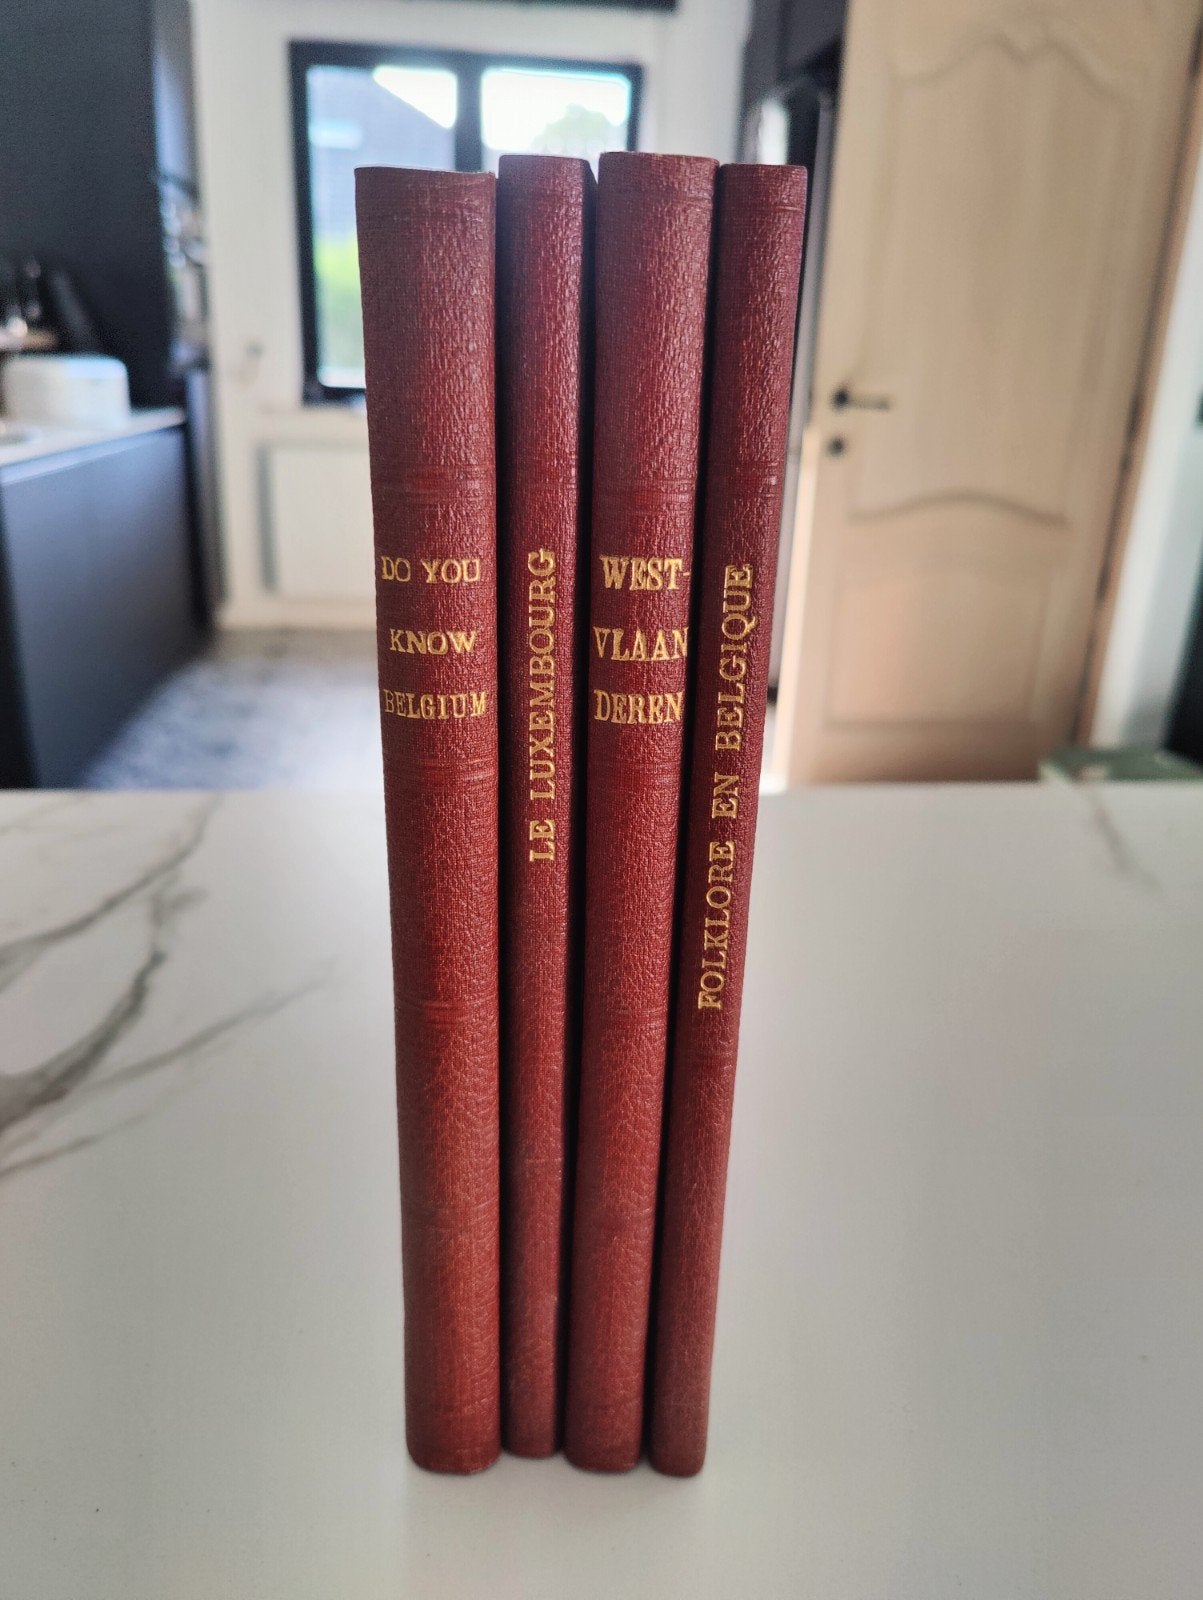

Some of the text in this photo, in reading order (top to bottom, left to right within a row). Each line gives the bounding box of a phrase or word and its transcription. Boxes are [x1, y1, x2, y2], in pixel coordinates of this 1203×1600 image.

[381, 556, 480, 584] DO YOU
[600, 555, 690, 591] WEST-
[390, 628, 478, 655] KNOW
[593, 626, 689, 661] VLAAN
[383, 689, 487, 719] BELGIUM
[528, 548, 556, 862] LE LUXEMBOURG
[594, 689, 684, 724] DEREN
[698, 564, 758, 1010] FOLKLORE EN BELGIQUE
